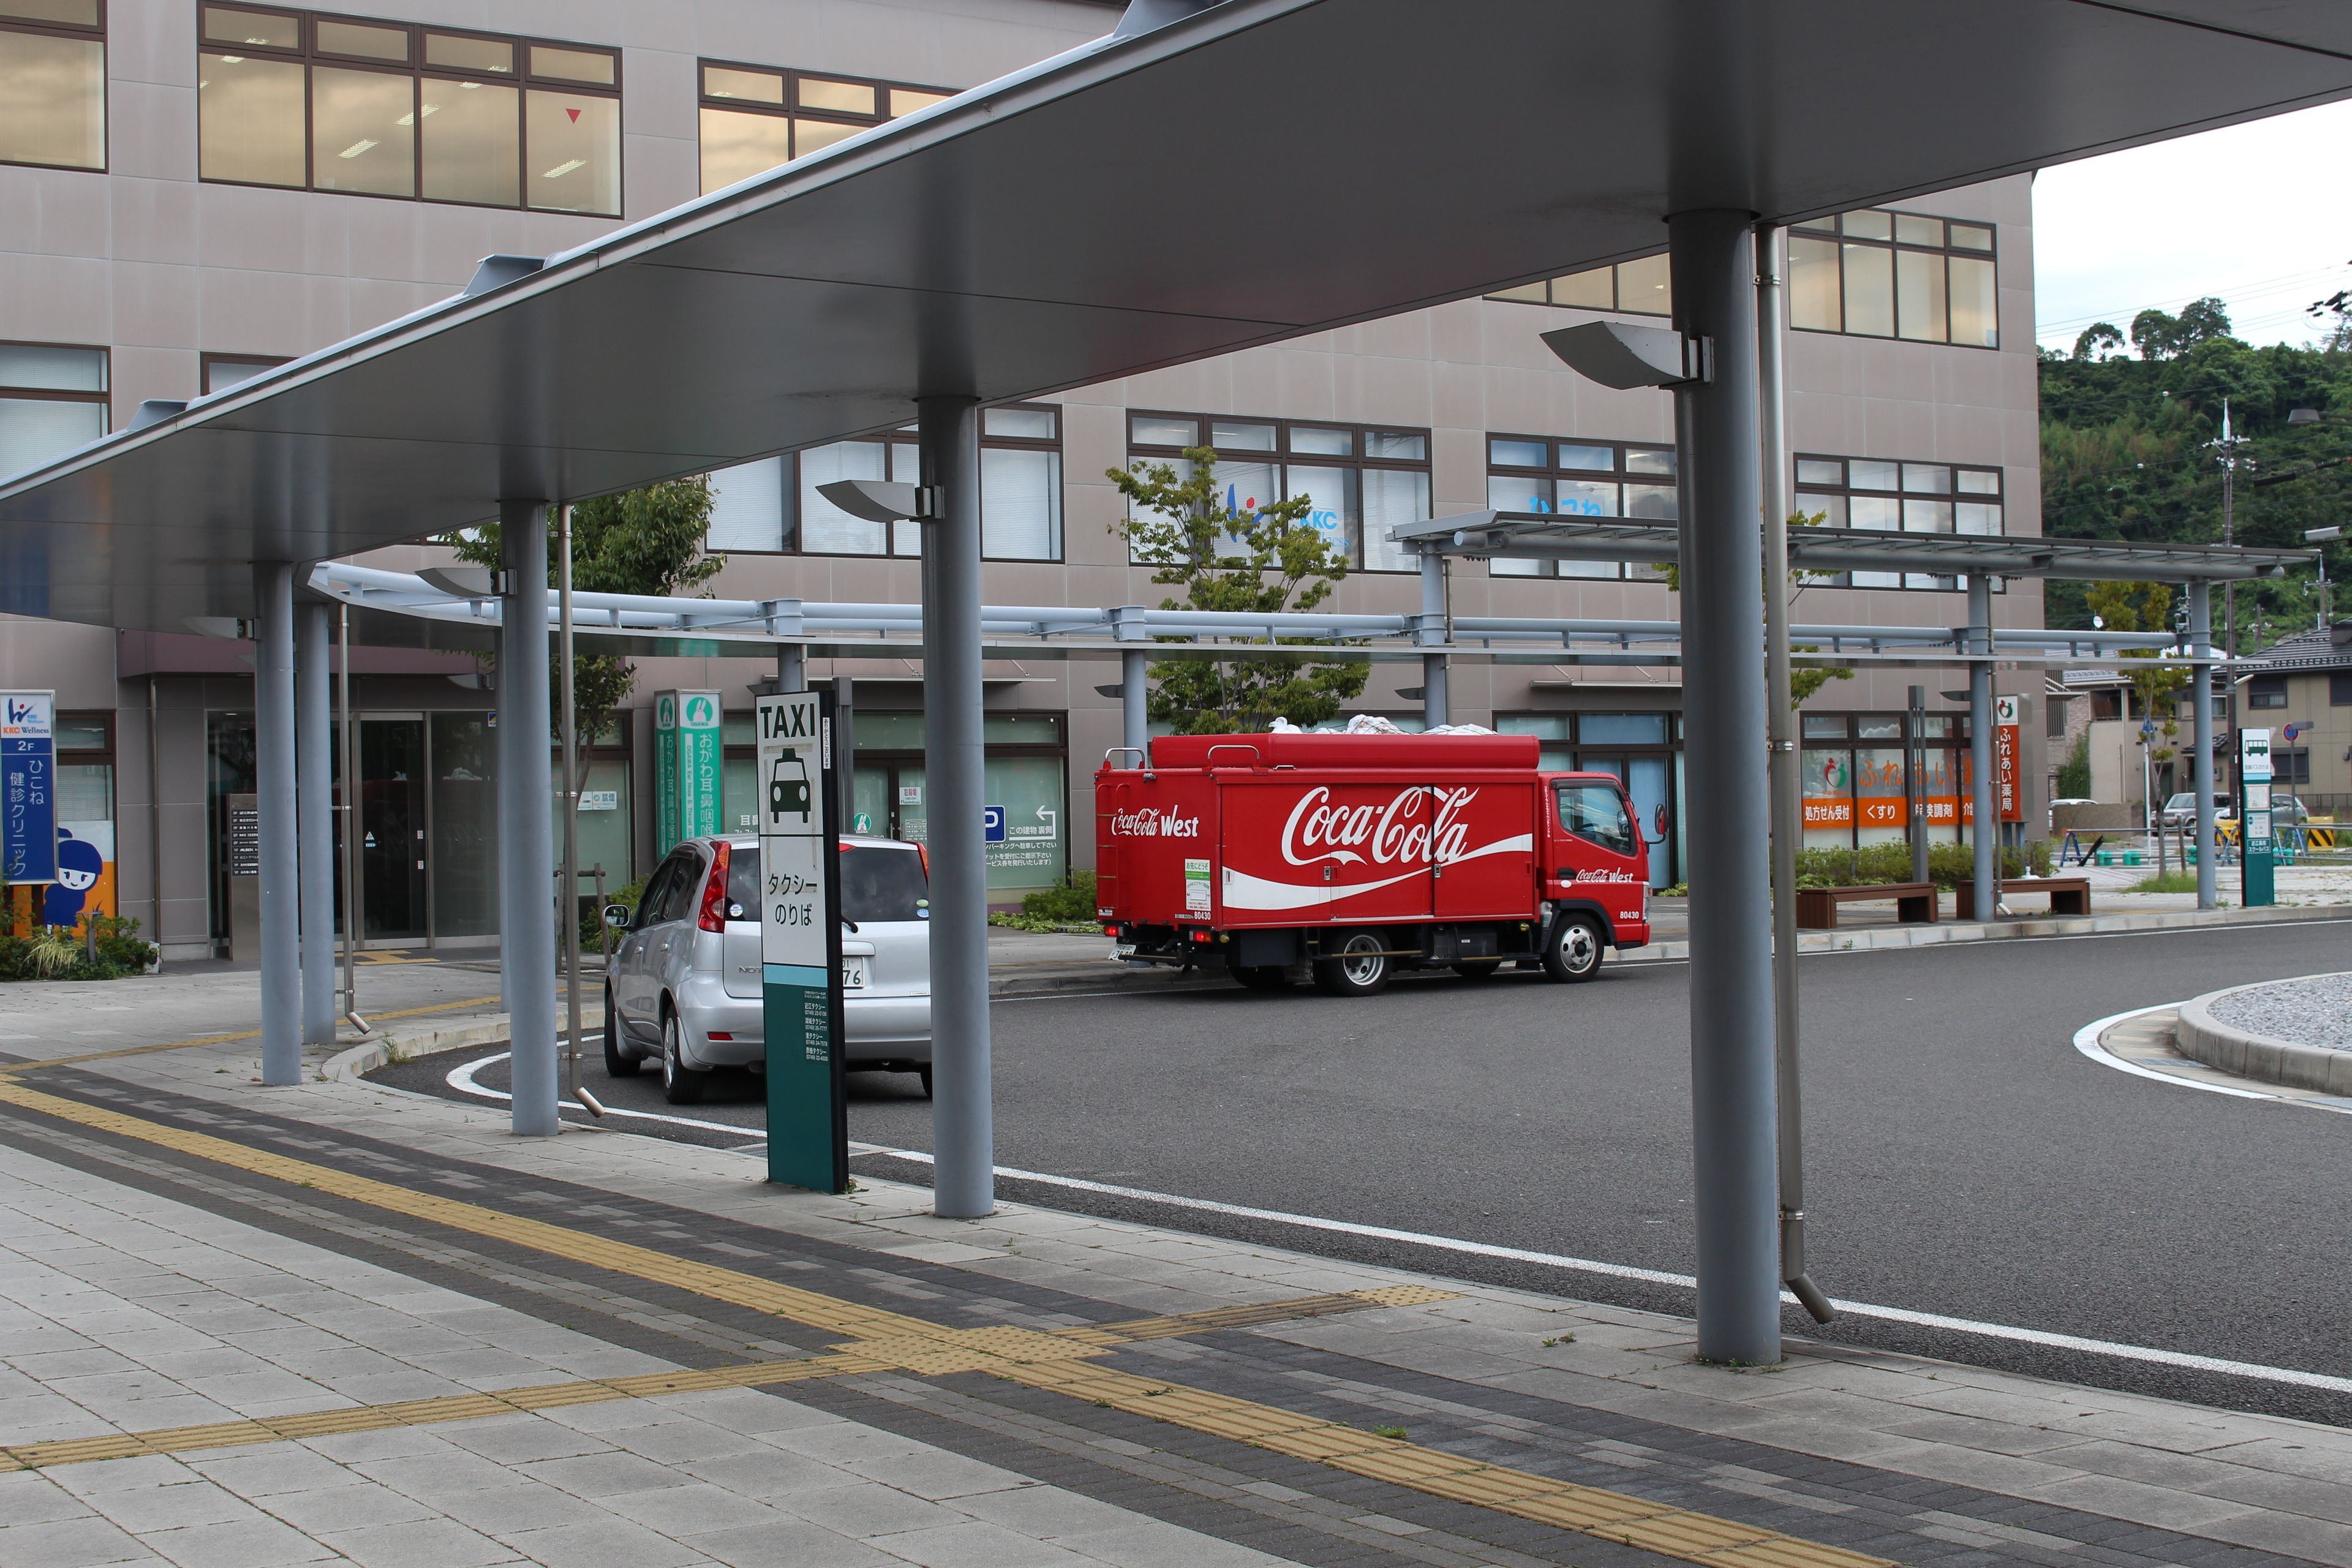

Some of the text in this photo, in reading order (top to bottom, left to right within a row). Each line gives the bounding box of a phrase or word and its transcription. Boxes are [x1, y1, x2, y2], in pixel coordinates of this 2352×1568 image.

[760, 703, 815, 739] TAXI
[18, 741, 34, 751] 2F
[2000, 728, 2012, 811] ふれあい薬局
[29, 760, 44, 805] ひこね
[1161, 804, 1199, 837] West
[1805, 805, 1850, 821] 処方せん受付
[1867, 804, 1895, 819] くすり
[10, 772, 26, 876] 健診クリニック
[1281, 786, 1479, 866] Coca-Cola
[769, 873, 818, 895] タクシー
[1575, 867, 1634, 883] Coca-Cola West
[775, 903, 813, 926] のりば
[1194, 911, 1211, 920] 80430
